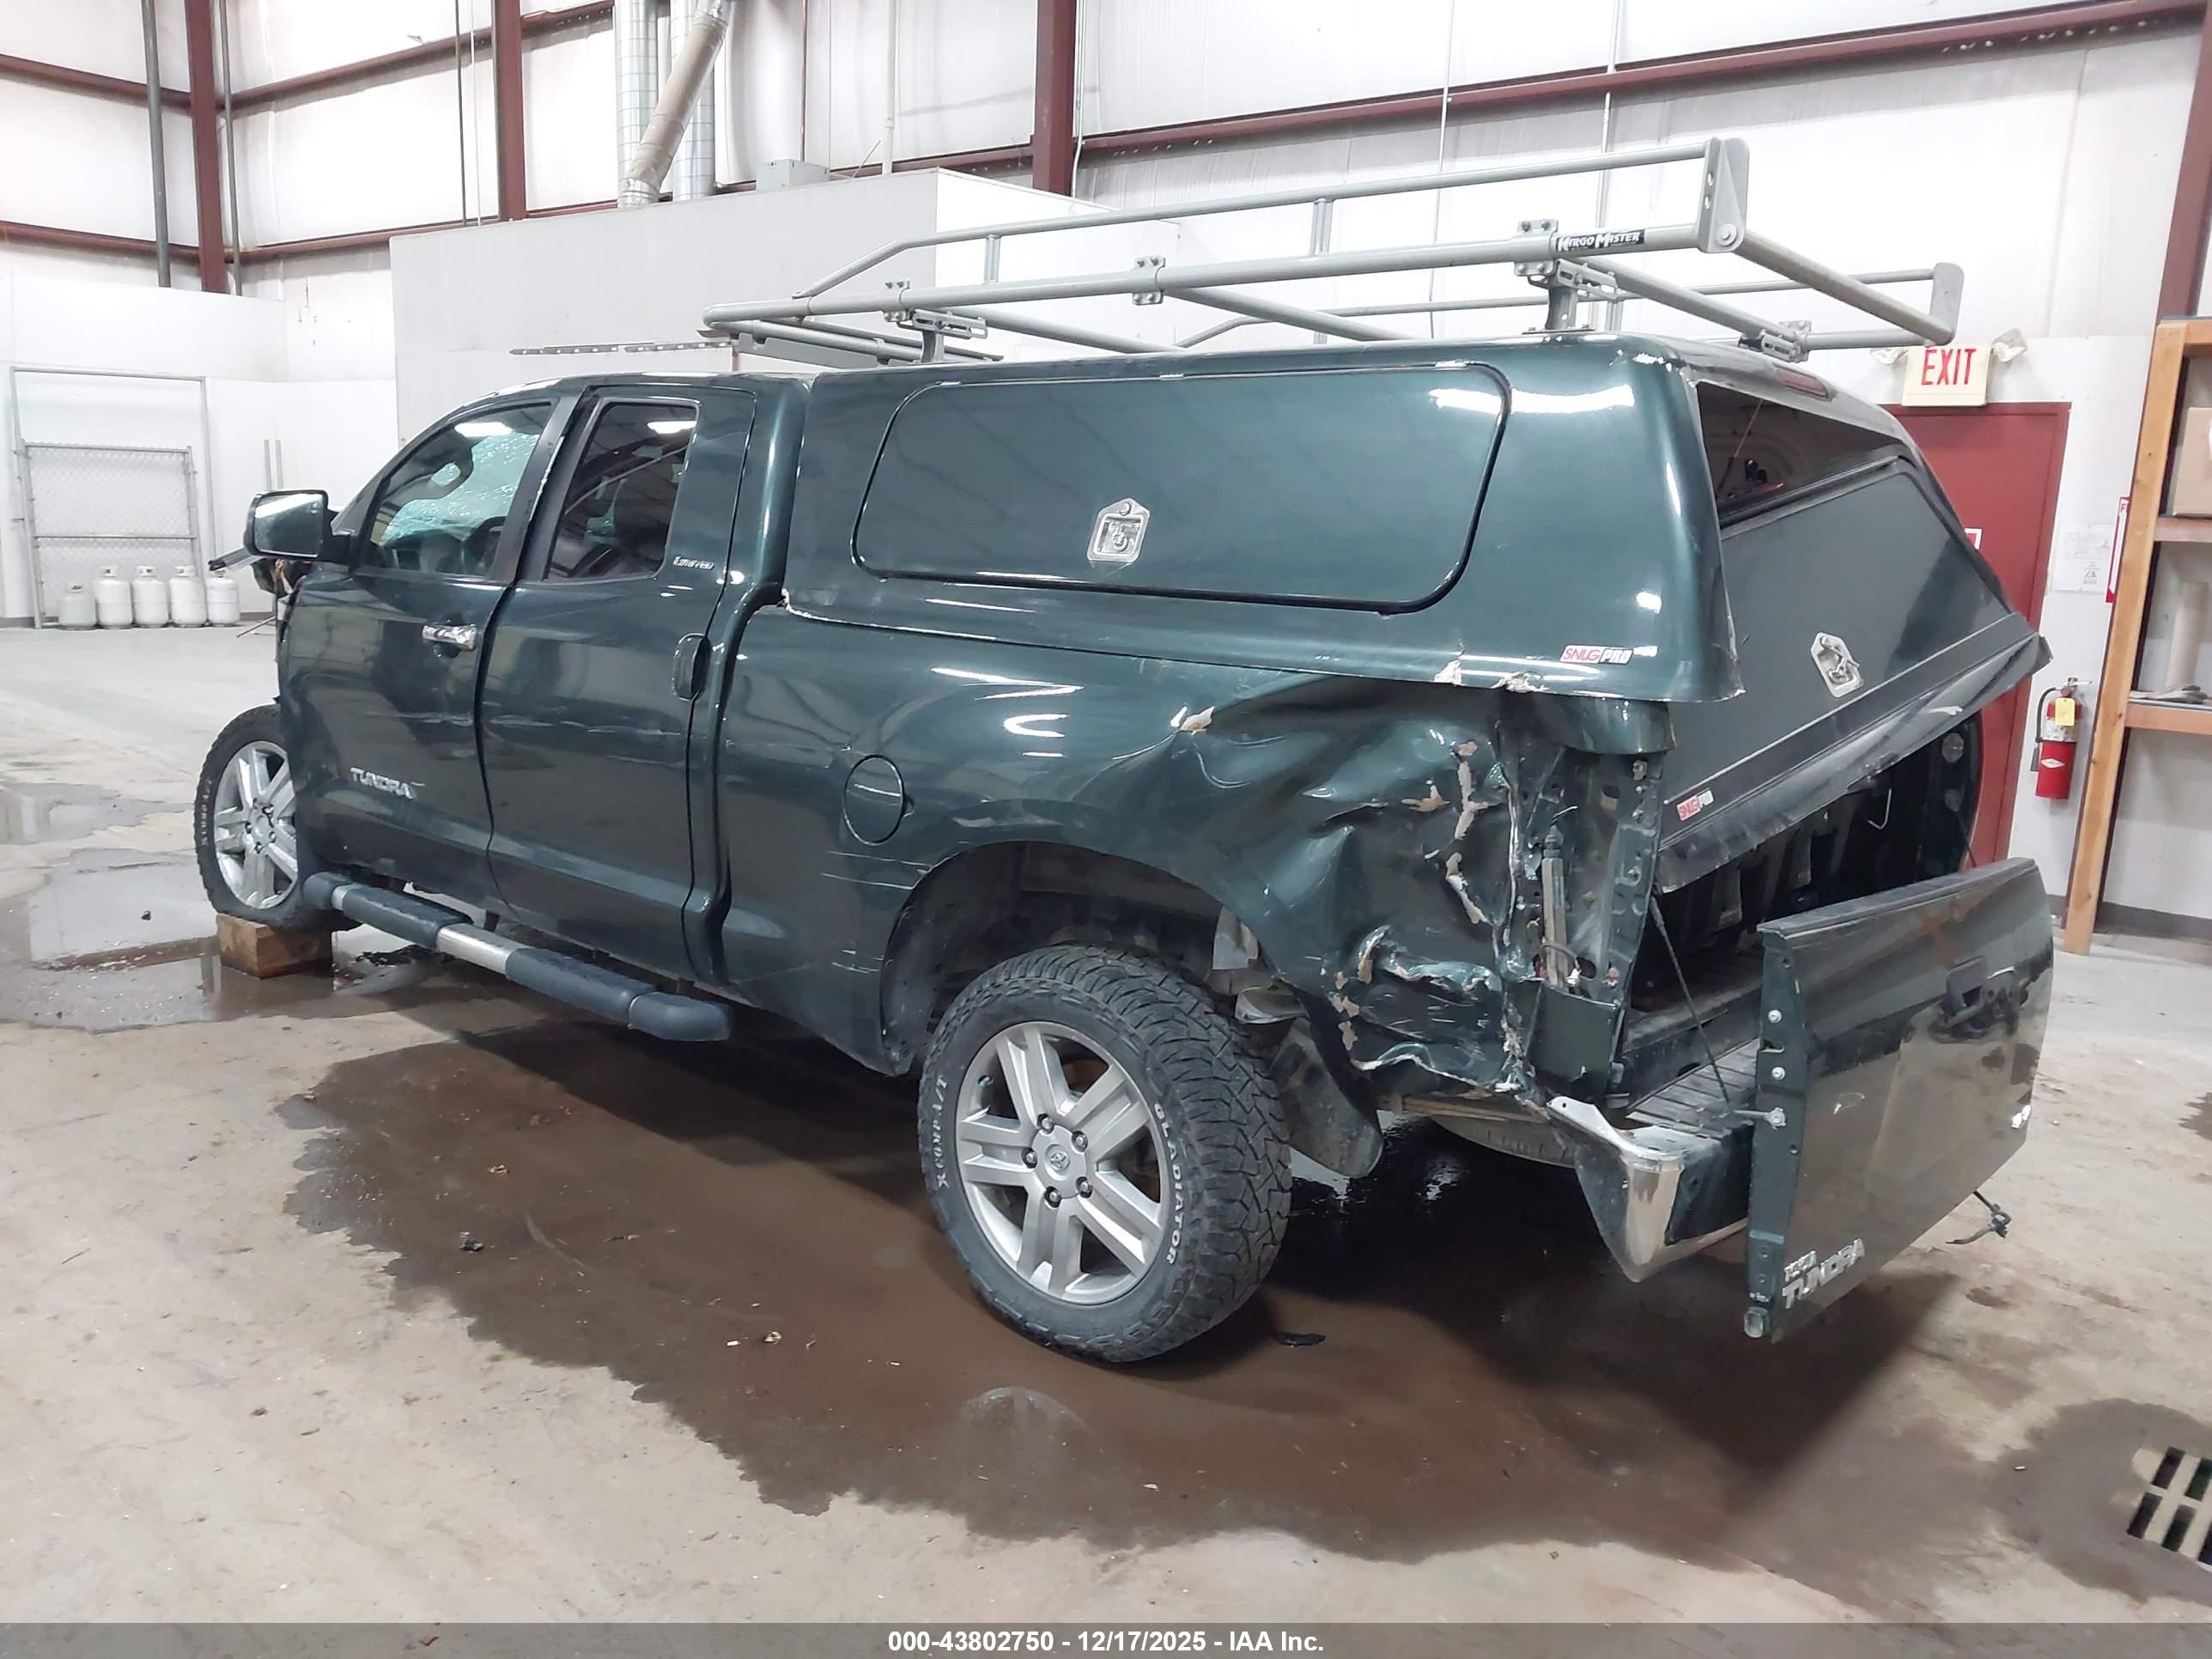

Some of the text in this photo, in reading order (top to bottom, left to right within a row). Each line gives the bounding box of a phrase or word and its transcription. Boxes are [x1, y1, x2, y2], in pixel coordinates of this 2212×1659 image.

[1922, 348, 1977, 386] EXIT
[349, 767, 417, 799] TUNDRA
[1154, 1103, 1184, 1265] GLADIATOR
[1782, 1237, 1865, 1310] TUNDRA
